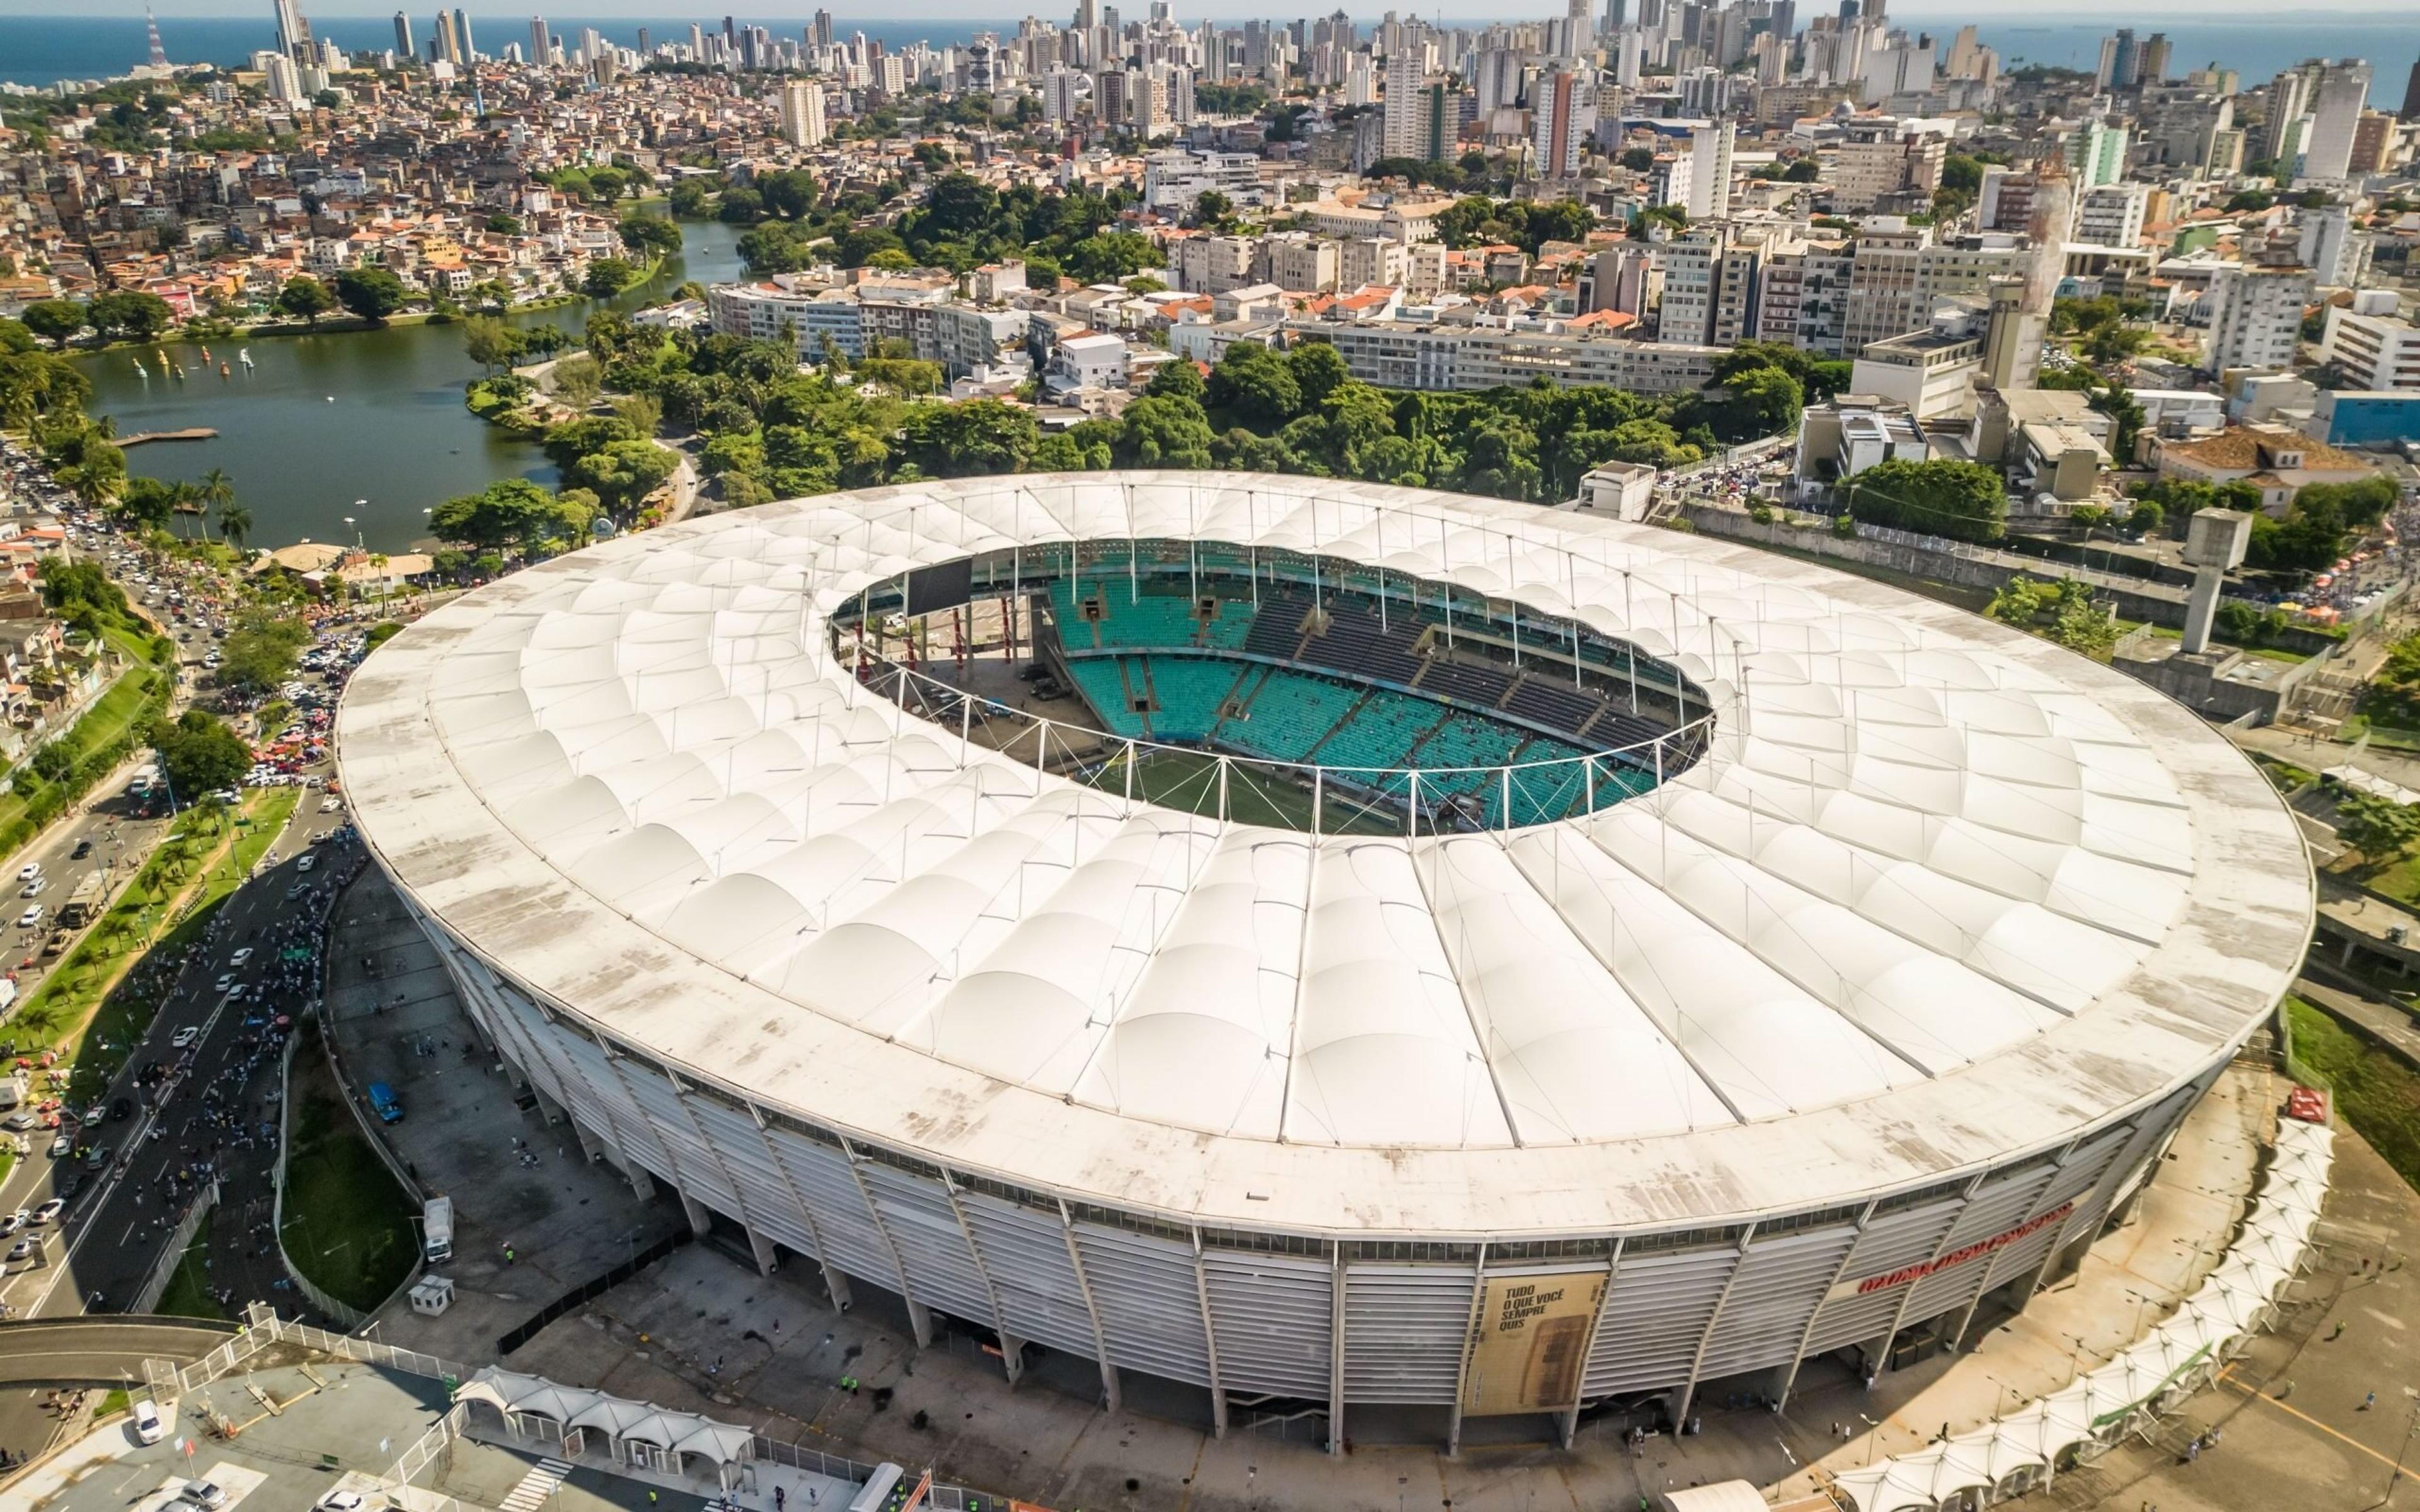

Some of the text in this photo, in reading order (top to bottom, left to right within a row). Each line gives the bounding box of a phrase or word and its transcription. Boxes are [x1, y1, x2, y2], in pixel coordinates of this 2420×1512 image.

[1504, 1288, 1564, 1310] O QUE VOCÊ
[1506, 1285, 1535, 1299] TUDO
[1501, 1304, 1547, 1320] SEMPRE
[1499, 1319, 1524, 1331] QUIS
